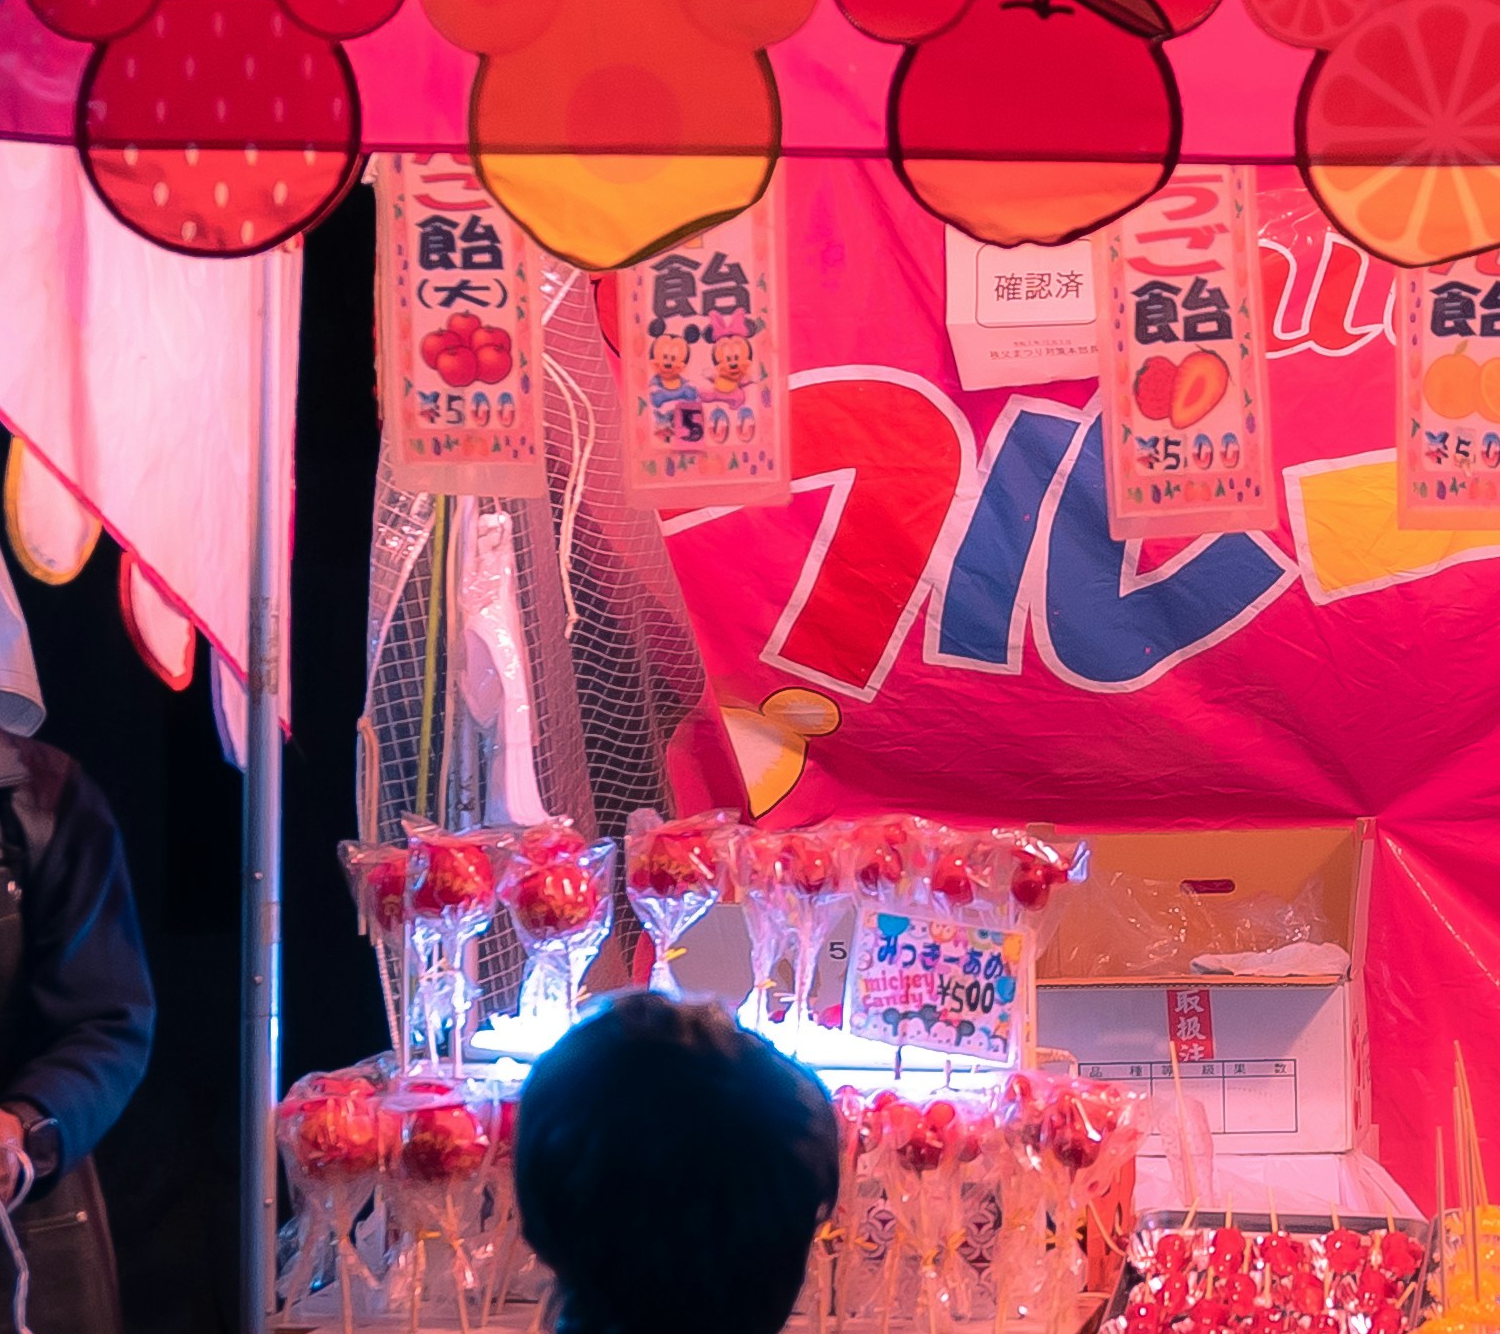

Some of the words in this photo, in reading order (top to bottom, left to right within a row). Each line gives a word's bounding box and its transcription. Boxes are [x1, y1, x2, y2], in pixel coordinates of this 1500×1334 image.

[994, 270, 1083, 301] 確認済
[417, 391, 517, 428] ¥500
[654, 404, 757, 443] ¥500
[1135, 432, 1243, 471] ¥500
[829, 941, 848, 960] 5
[864, 970, 938, 1000] mickey
[936, 974, 996, 1014] ¥500
